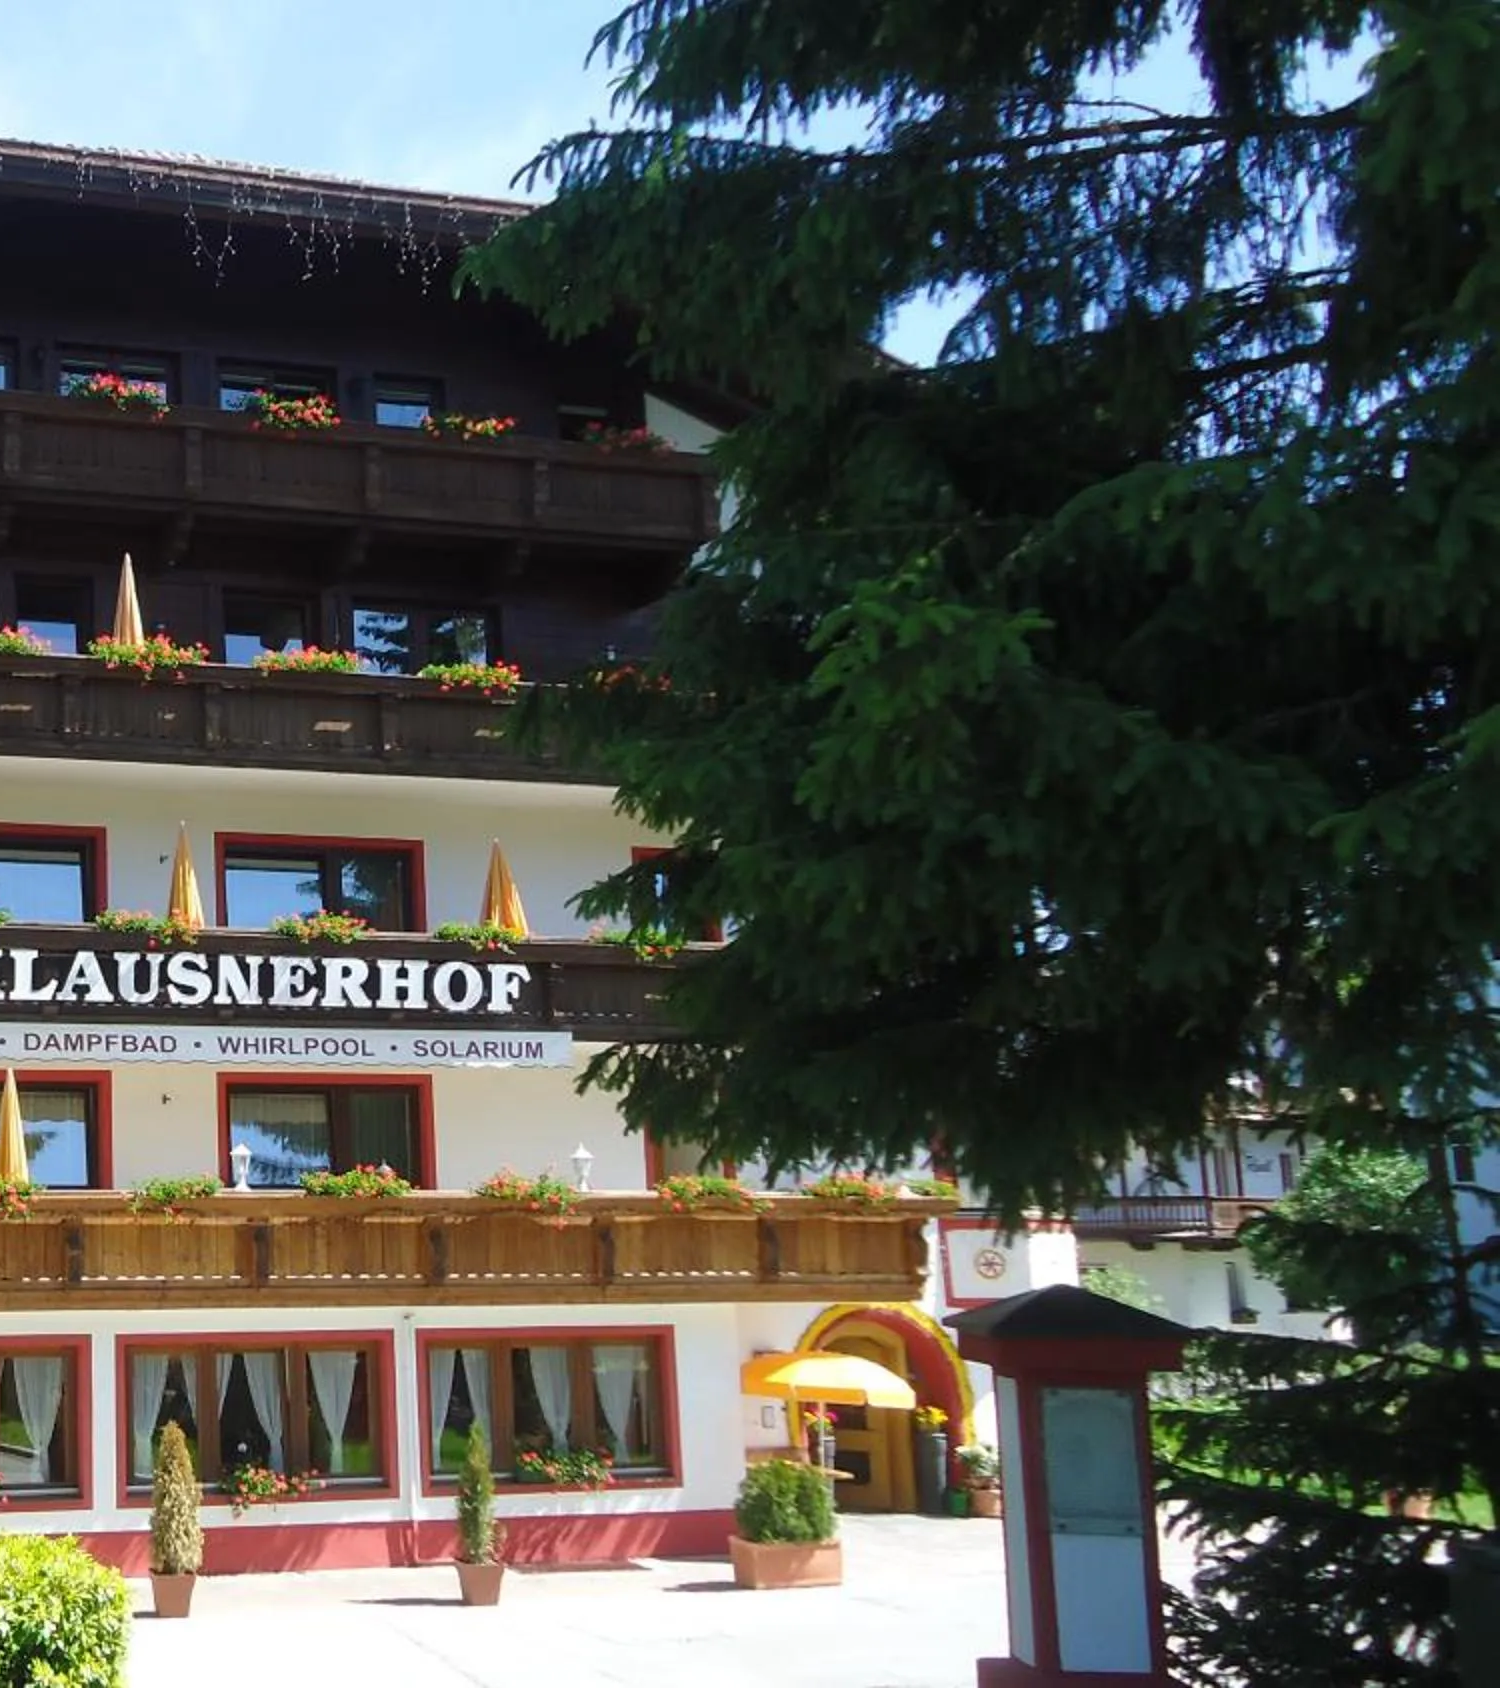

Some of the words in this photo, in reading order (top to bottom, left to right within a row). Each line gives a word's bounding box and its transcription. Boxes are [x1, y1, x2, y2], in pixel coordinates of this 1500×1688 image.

[22, 1031, 178, 1054] DAMPFBAD
[216, 1035, 376, 1057] WHIRLPOOL
[412, 1038, 545, 1060] SOLARIUM
